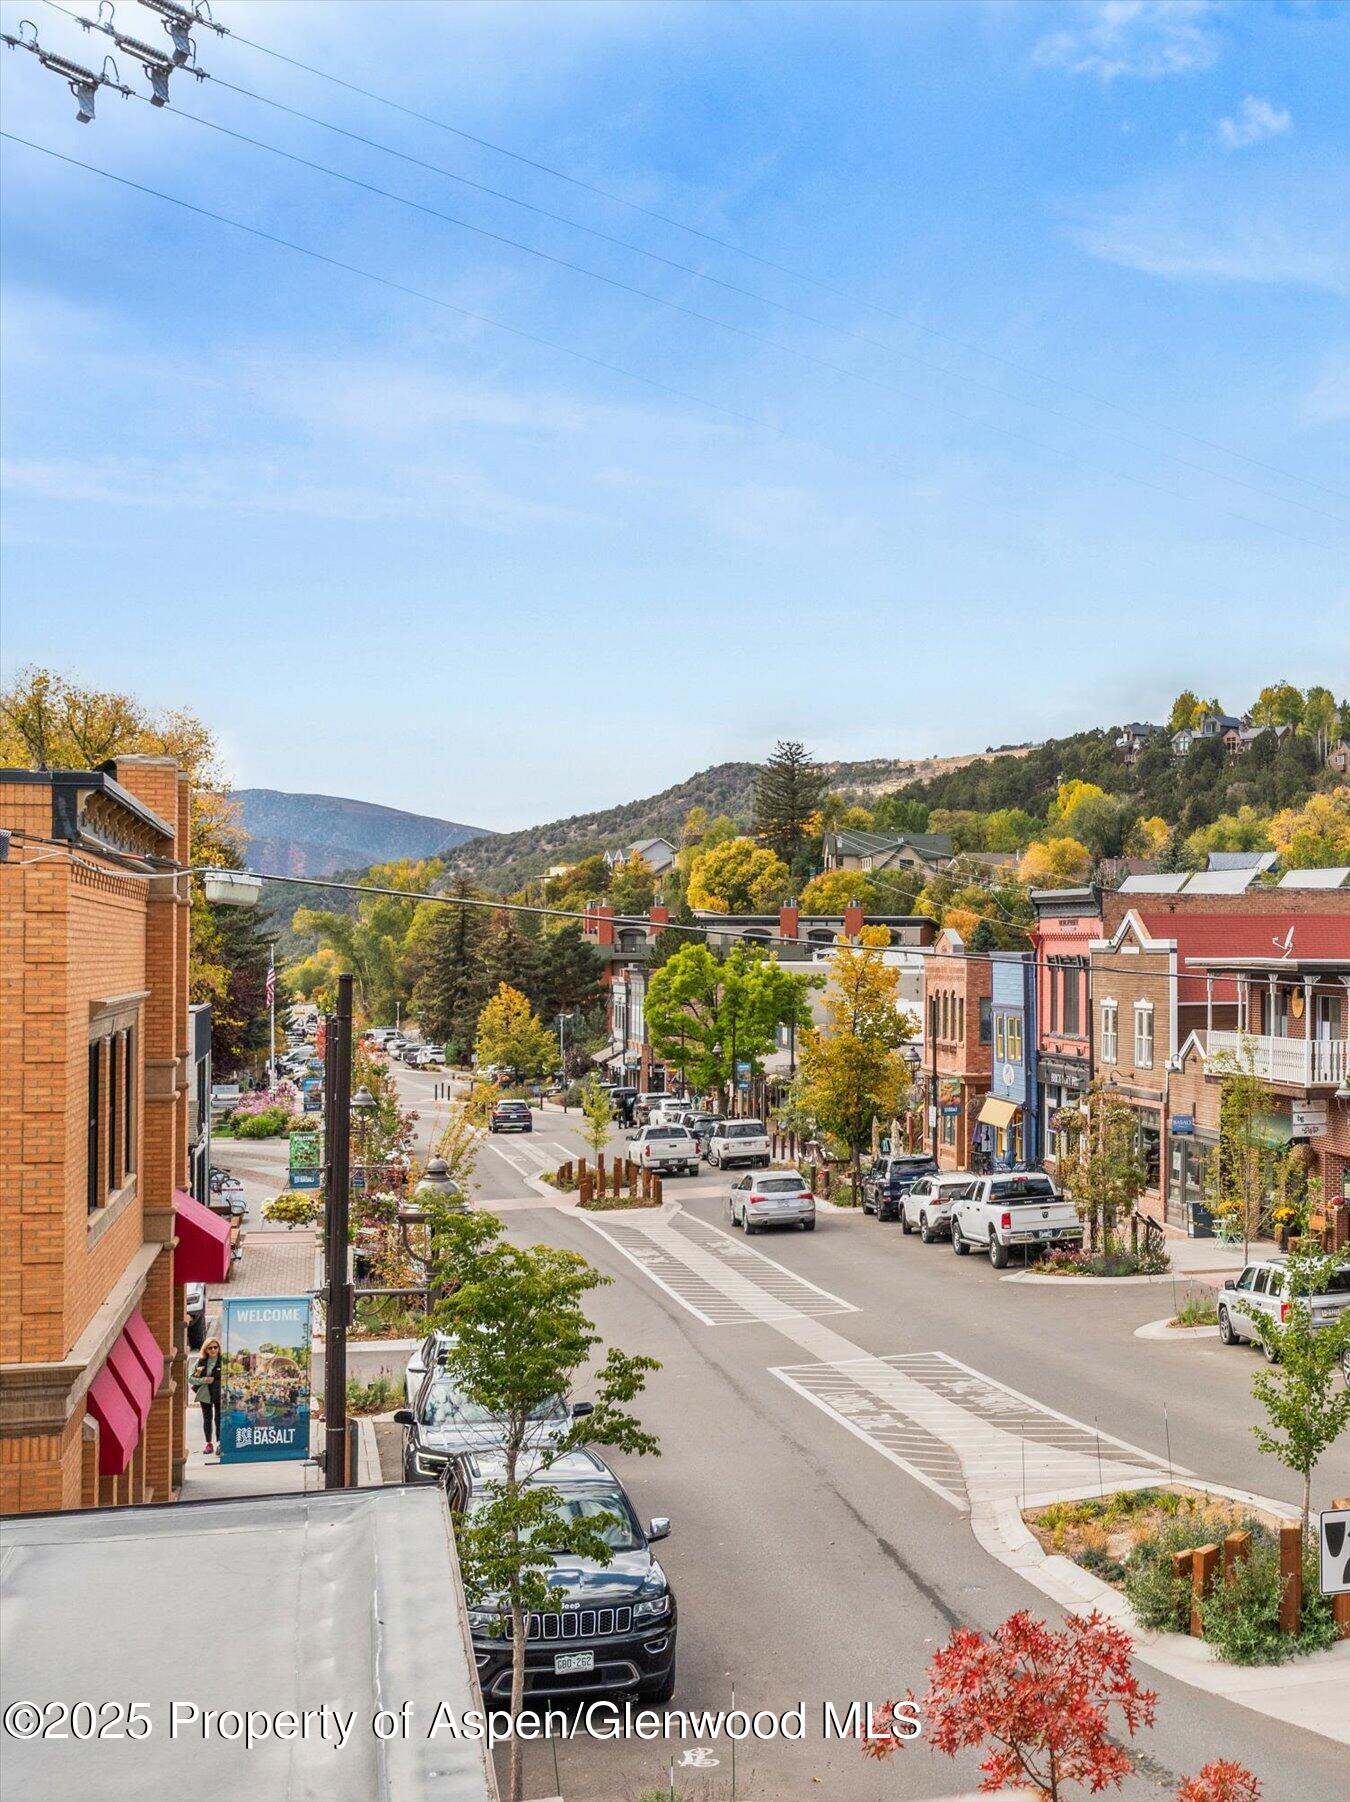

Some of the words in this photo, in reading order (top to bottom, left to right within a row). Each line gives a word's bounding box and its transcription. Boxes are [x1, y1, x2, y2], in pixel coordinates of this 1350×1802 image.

[236, 1308, 300, 1323] WELCOME
[253, 1428, 296, 1445] BASALT
[561, 1602, 581, 1610] Jeep
